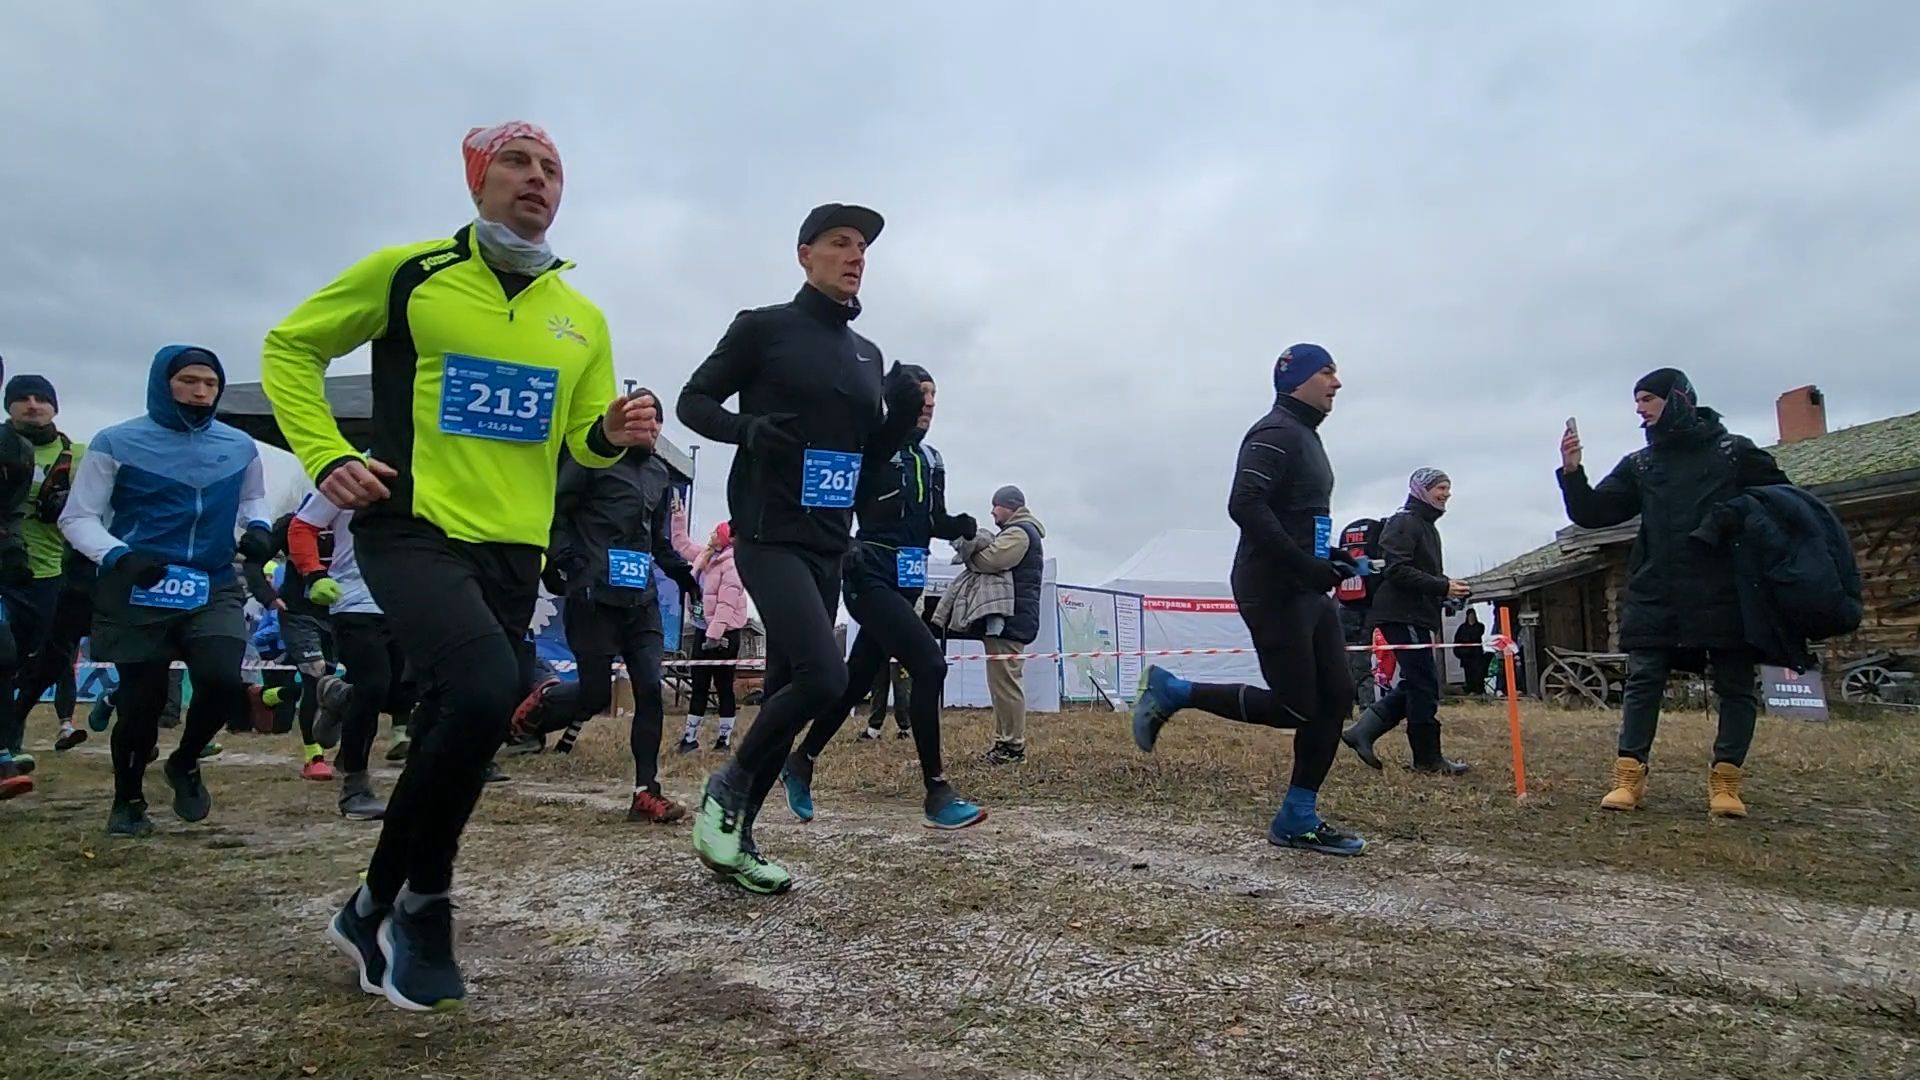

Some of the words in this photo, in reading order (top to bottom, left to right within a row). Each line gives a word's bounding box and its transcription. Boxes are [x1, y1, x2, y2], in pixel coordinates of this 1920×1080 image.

[467, 383, 539, 418] 213
[819, 468, 854, 490] 261
[620, 561, 646, 577] 251
[149, 579, 196, 597] 208
